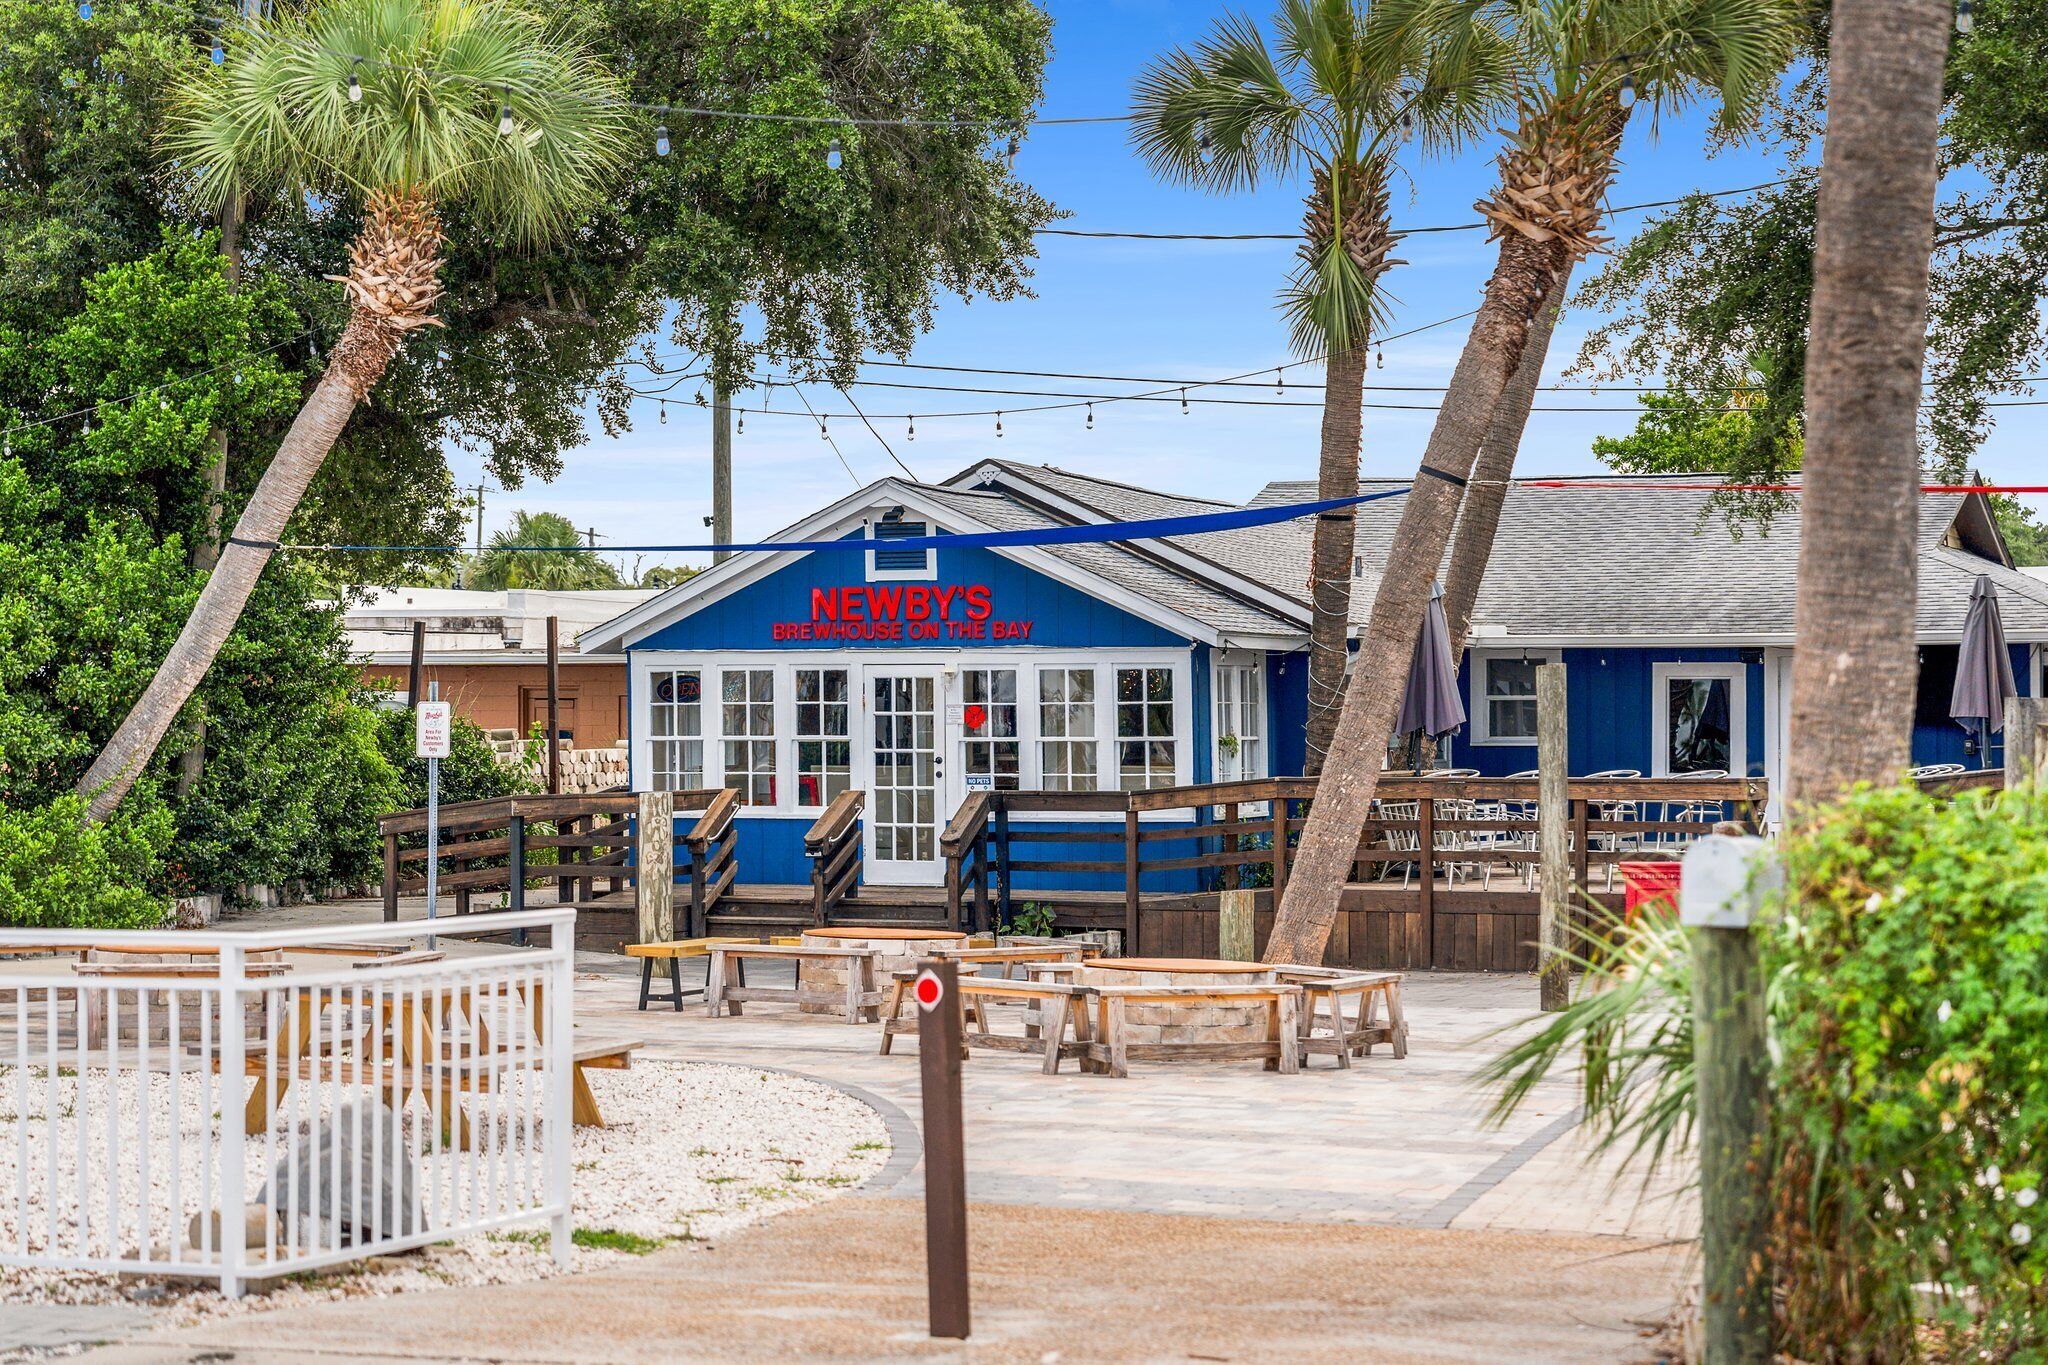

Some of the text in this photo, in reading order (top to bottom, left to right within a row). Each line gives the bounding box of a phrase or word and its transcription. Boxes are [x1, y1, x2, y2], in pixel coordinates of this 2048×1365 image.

[811, 585, 993, 621] NEWBY'S
[772, 621, 1034, 640] BREWHOUSE ON THE BAY
